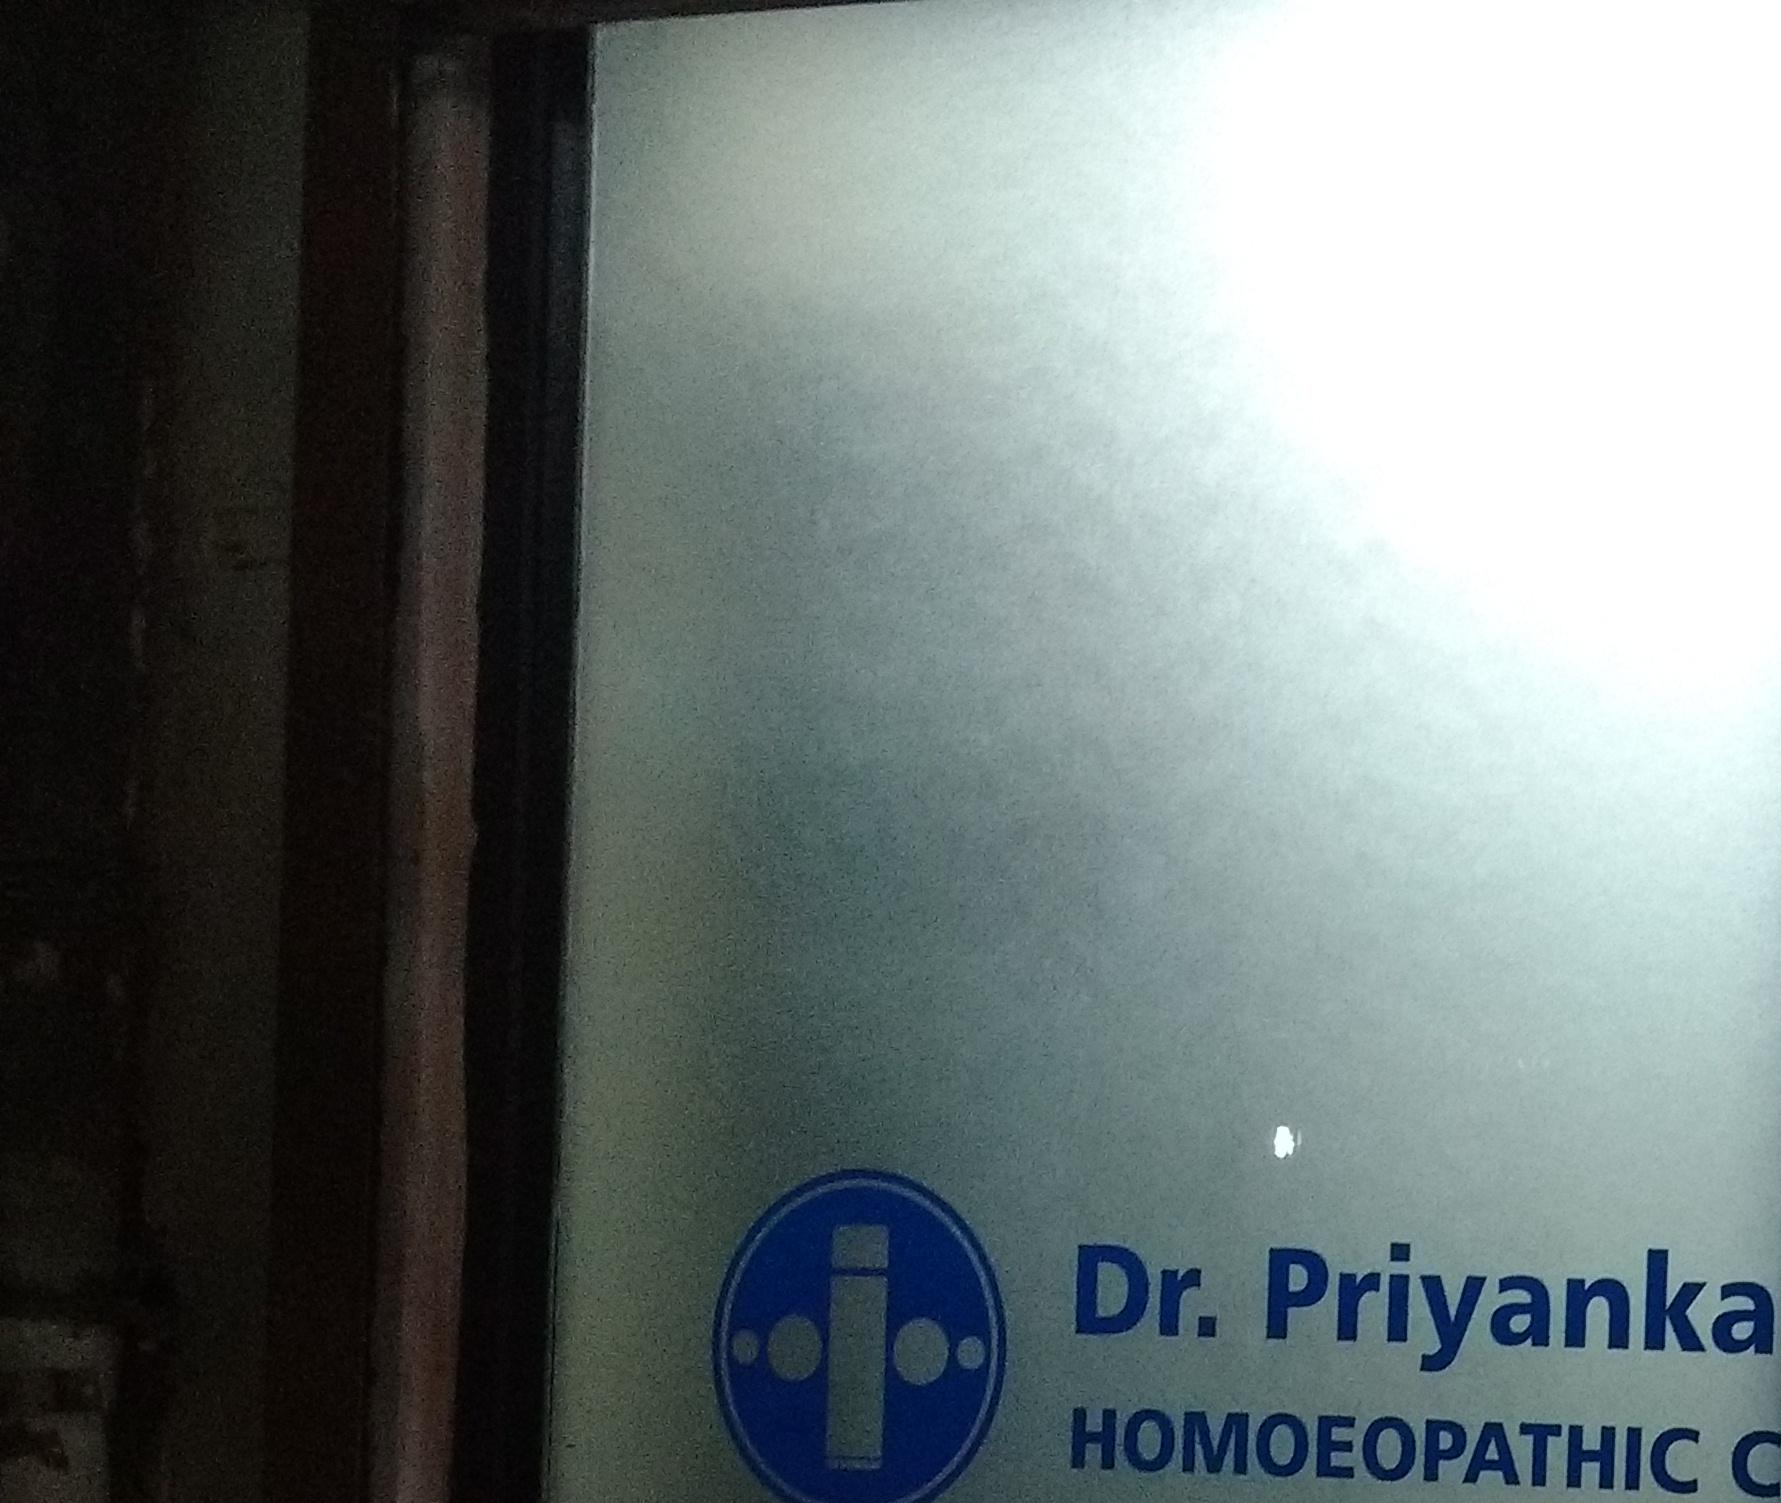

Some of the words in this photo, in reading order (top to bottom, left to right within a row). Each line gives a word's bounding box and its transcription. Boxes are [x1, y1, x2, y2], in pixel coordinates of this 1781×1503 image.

[1074, 1243, 1218, 1338] Dr.
[1265, 1243, 1776, 1372] Priyanka
[1068, 1405, 1700, 1494] HOMOEOPATHIC
